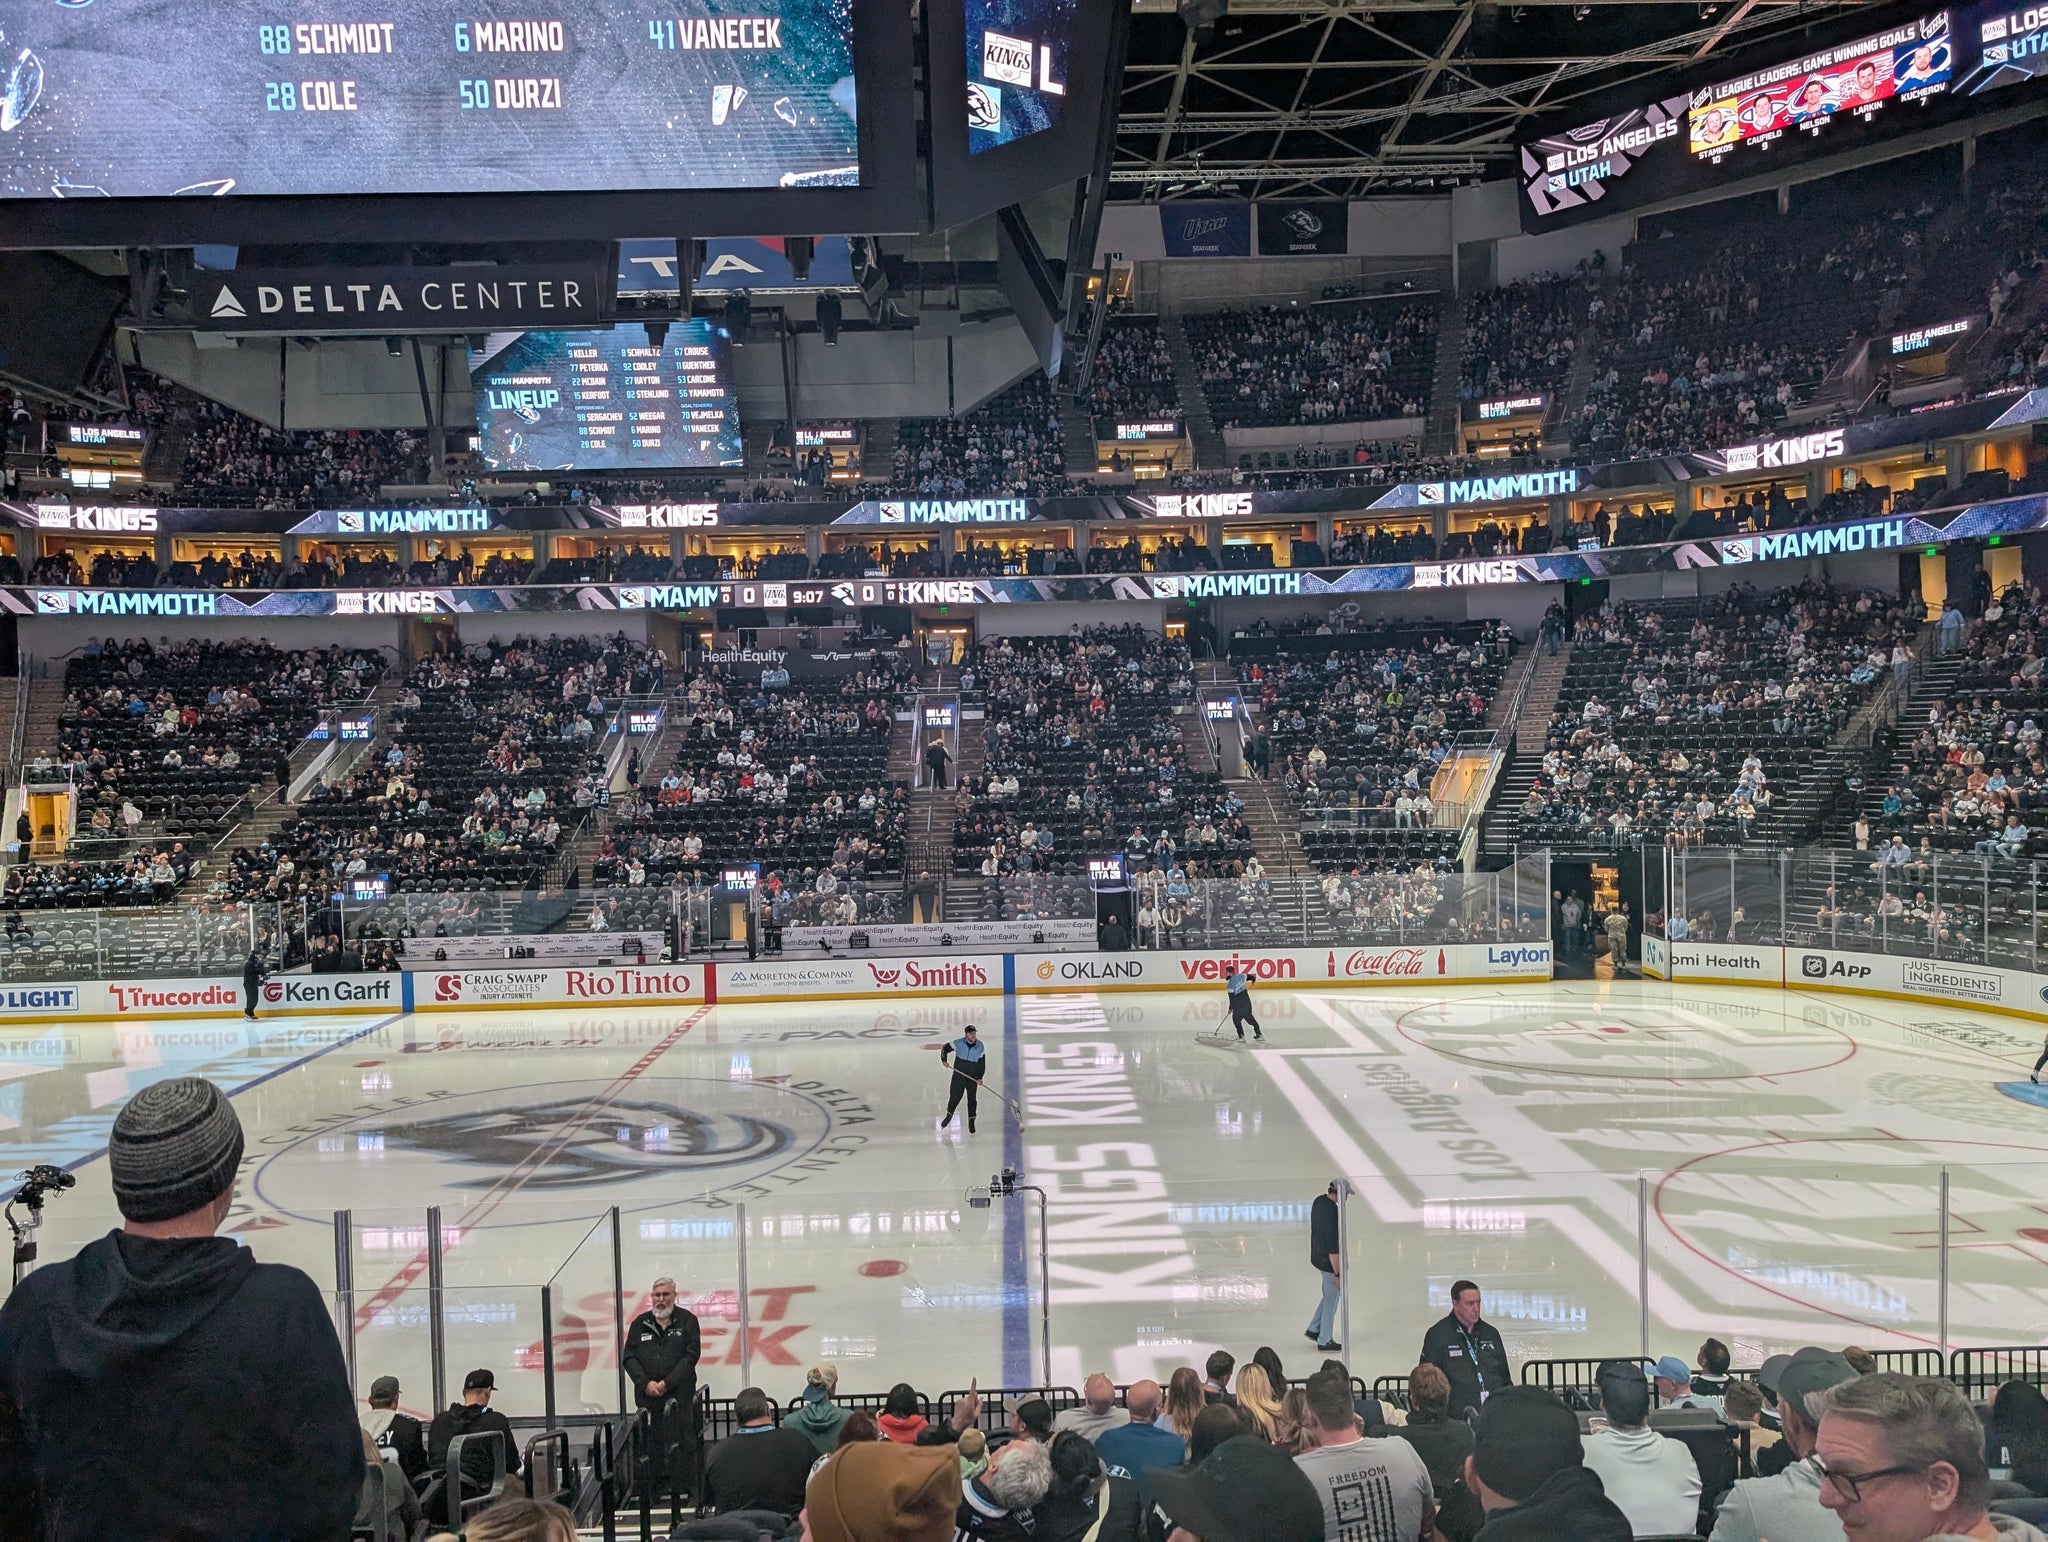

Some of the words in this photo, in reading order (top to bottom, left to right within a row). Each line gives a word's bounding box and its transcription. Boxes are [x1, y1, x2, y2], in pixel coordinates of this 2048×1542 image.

[2011, 6, 2048, 34] LOS
[260, 25, 290, 54] 88
[295, 23, 394, 54] SCHMIDT
[454, 22, 470, 52] 6
[475, 19, 564, 52] MARINO
[649, 20, 675, 50] 41
[678, 18, 782, 50] VANECEK
[986, 44, 1030, 70] KINGS
[1716, 78, 1753, 100] LEAGUE
[1754, 64, 1802, 88] LEADERS:
[1803, 52, 1832, 73] GAME
[1834, 38, 1878, 64] WINNING
[1879, 27, 1915, 52] GOALS
[265, 82, 296, 111] 28
[301, 80, 358, 111] COLE
[459, 79, 490, 109] 50
[494, 78, 562, 109] DURZI
[1900, 82, 1946, 103] KUCHEROV
[1853, 100, 1883, 116] LARKIN
[1920, 97, 1926, 106] 7
[1799, 115, 1831, 131] NELSON
[1865, 113, 1872, 122] 8
[1746, 129, 1782, 146] CAUFIELD
[1812, 128, 1819, 137] 9
[1567, 142, 1599, 166] LOS
[1602, 119, 1678, 156] ANGELES
[1761, 142, 1768, 151] 9
[1698, 143, 1734, 160] STAMKOS
[1711, 155, 1721, 165] 10
[1569, 160, 1611, 187] UTAH
[257, 284, 402, 314] DELTA
[420, 280, 582, 311] CENTER
[1904, 330, 1923, 343] LOS
[1924, 320, 1968, 338] ANGELES
[684, 347, 709, 356] CROUSE
[1904, 339, 1929, 351] UTAH
[573, 349, 598, 358] KELLER
[570, 364, 578, 372] 77
[579, 363, 608, 372] PETERKA
[623, 363, 632, 371] 92
[632, 362, 657, 371] COOLEY
[676, 362, 682, 370] 11
[682, 361, 716, 370] GUENTHER
[491, 377, 511, 385] UTAH
[512, 376, 551, 385] MAMMOTH
[572, 378, 581, 386] 22
[624, 377, 633, 385] 27
[634, 376, 660, 385] HAYTON
[677, 376, 686, 384] 53
[686, 375, 716, 384] CARCONE
[488, 389, 560, 410] LINEUP
[574, 392, 581, 400] 15
[581, 391, 610, 400] KERFOOT
[626, 390, 635, 398] 82
[679, 389, 688, 397] 56
[688, 388, 725, 397] YAMAMOTO
[1490, 401, 1505, 410] LOS
[1506, 397, 1541, 409] ANGELES
[577, 413, 586, 421] 98
[586, 413, 622, 421] SERGACHEV
[629, 412, 638, 420] 52
[639, 412, 665, 420] WEEGAR
[681, 411, 690, 419] 70
[690, 410, 724, 419] VEJMELKA
[1490, 408, 1510, 417] UTAH
[82, 427, 99, 436] LOS
[101, 429, 140, 439] ANGELES
[588, 426, 615, 434] SCHMIDT
[631, 426, 636, 434] 6
[636, 425, 661, 434] MARINO
[683, 425, 690, 433] 41
[691, 424, 719, 433] VANECEK
[1127, 424, 1141, 432] LOS
[1142, 424, 1173, 432] ANGELES
[1127, 431, 1146, 439] UTAH
[82, 435, 105, 443] UTAH
[590, 440, 606, 448] COLE
[632, 440, 641, 448] 50
[1763, 429, 1845, 467] KINGS
[1449, 470, 1577, 503] MAMMOTH
[910, 499, 1026, 523] MAMMOTH
[1186, 493, 1253, 516] KINGS
[76, 506, 158, 531] KINGS
[370, 508, 488, 533] MAMMOTH
[650, 503, 719, 527] KINGS
[1759, 520, 1903, 561] MAMMOTH
[1445, 560, 1518, 586] KINGS
[1183, 573, 1300, 597] MAMMOTH
[723, 594, 729, 603] 0
[743, 588, 755, 603] 0
[793, 591, 824, 603] 9:07
[862, 586, 874, 601] 0
[888, 591, 894, 600] 0
[908, 581, 974, 604] KINGS
[76, 592, 216, 616] MAMMOTH
[367, 591, 436, 614] KINGS
[701, 649, 786, 665] HealthEquity
[936, 708, 951, 717] LAK
[1217, 702, 1233, 710] LAK
[351, 721, 369, 730] LAK
[641, 715, 657, 724] LAK
[1101, 861, 1120, 871] LAK
[737, 871, 756, 880] LAK
[366, 881, 383, 890] LAK
[904, 925, 944, 934] HealthEquity
[954, 923, 994, 932] HealthEquity
[1003, 922, 1044, 931] HealthEquity
[879, 935, 920, 944] HealthEquity
[979, 933, 1019, 941] HealthEquity
[1488, 946, 1549, 967] Layton
[1706, 955, 1760, 969] Health
[1061, 960, 1143, 979] OKLAND
[1180, 953, 1296, 980] verizon
[1908, 961, 1937, 972] JUST
[464, 974, 503, 985] CRAIG
[507, 972, 548, 985] SWAPP
[750, 972, 796, 981] MORETON
[808, 970, 853, 980] COMPANY
[906, 961, 987, 988] Smith's
[1909, 971, 1996, 992] INGREDIENTS
[286, 981, 330, 1002] Ken
[334, 979, 390, 1001] Garff
[472, 985, 479, 993] &
[480, 983, 540, 993] ASSOCIATES
[566, 971, 614, 998] Rio
[616, 969, 690, 994] Tinto
[8, 991, 73, 1007] LIGHT
[128, 985, 237, 1008] Trucordia
[480, 992, 500, 1000] INJURY
[501, 991, 533, 999] ATTORNEYS
[1958, 991, 1978, 999] BETTER
[779, 1027, 941, 1042] PACS
[1024, 1041, 1145, 1125] KINGS
[790, 1081, 875, 1126] DELTA
[258, 1090, 456, 1145] CENTER
[692, 1135, 869, 1209] CENTER
[1029, 1142, 1195, 1305] KINGS
[1329, 1464, 1388, 1487] FREEDOM
